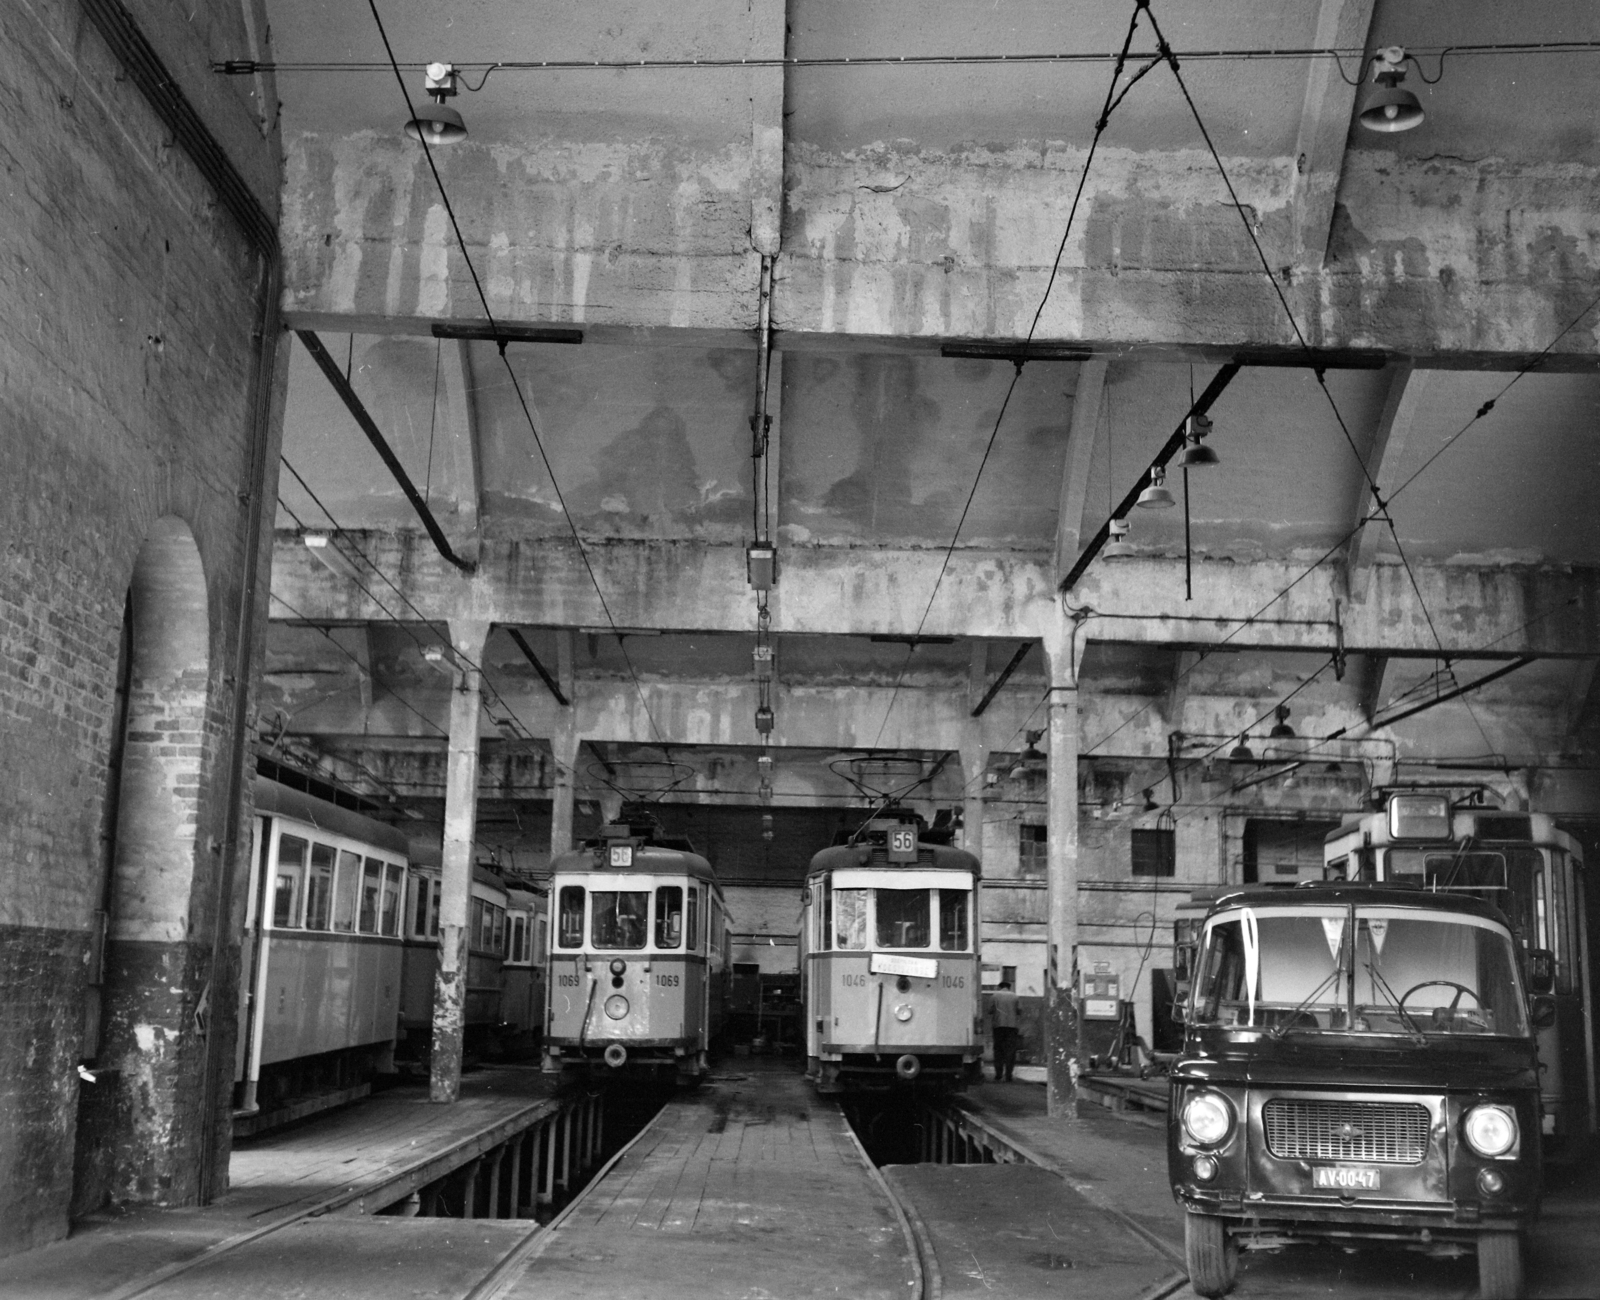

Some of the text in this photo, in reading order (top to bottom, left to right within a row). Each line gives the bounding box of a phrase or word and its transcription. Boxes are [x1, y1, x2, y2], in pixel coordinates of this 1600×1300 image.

[894, 832, 911, 849] 56
[558, 974, 580, 987] 1069
[656, 974, 680, 987] 1069
[842, 974, 866, 987] 1046
[942, 975, 965, 989] 1046
